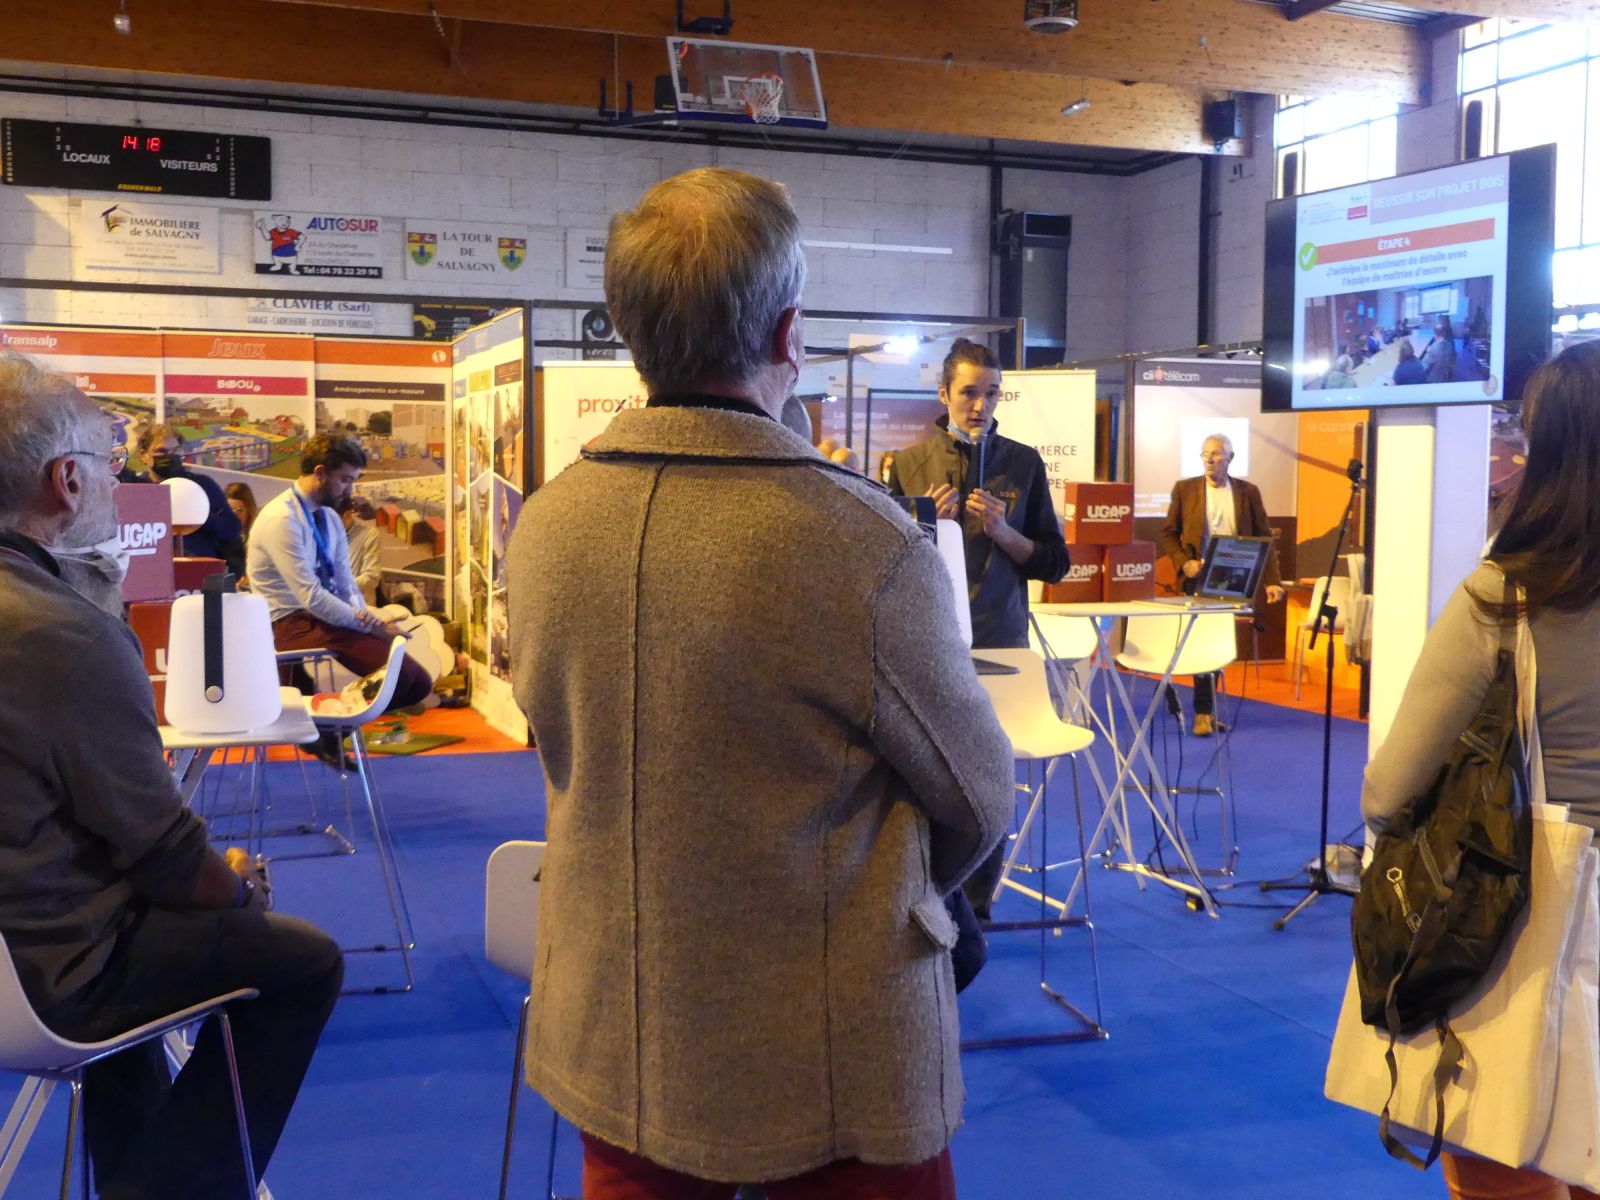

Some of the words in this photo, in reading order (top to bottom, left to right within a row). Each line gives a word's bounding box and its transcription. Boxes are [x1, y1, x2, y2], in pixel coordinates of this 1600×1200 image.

[63, 151, 111, 165] LOCAUX
[160, 158, 218, 172] VISITEURS
[1438, 178, 1478, 197] PROJET
[1479, 174, 1505, 190] BOIS
[130, 217, 201, 230] IMMOBILIERE
[307, 217, 378, 232] AUTOSUR
[130, 229, 142, 237] de
[145, 229, 201, 240] SALVAGNY
[443, 231, 457, 242] LA
[461, 232, 493, 244] TOUR
[460, 247, 476, 257] DE
[1447, 250, 1467, 260] avec
[437, 261, 497, 273] SALVAGNY
[273, 297, 333, 311] CLAVIER
[338, 302, 371, 313] (Sarl)
[2, 333, 57, 348] transalp
[208, 338, 266, 360] Jeux
[1087, 505, 1130, 518] UGAP
[119, 522, 167, 549] UGAP
[1116, 562, 1152, 577] UGAP
